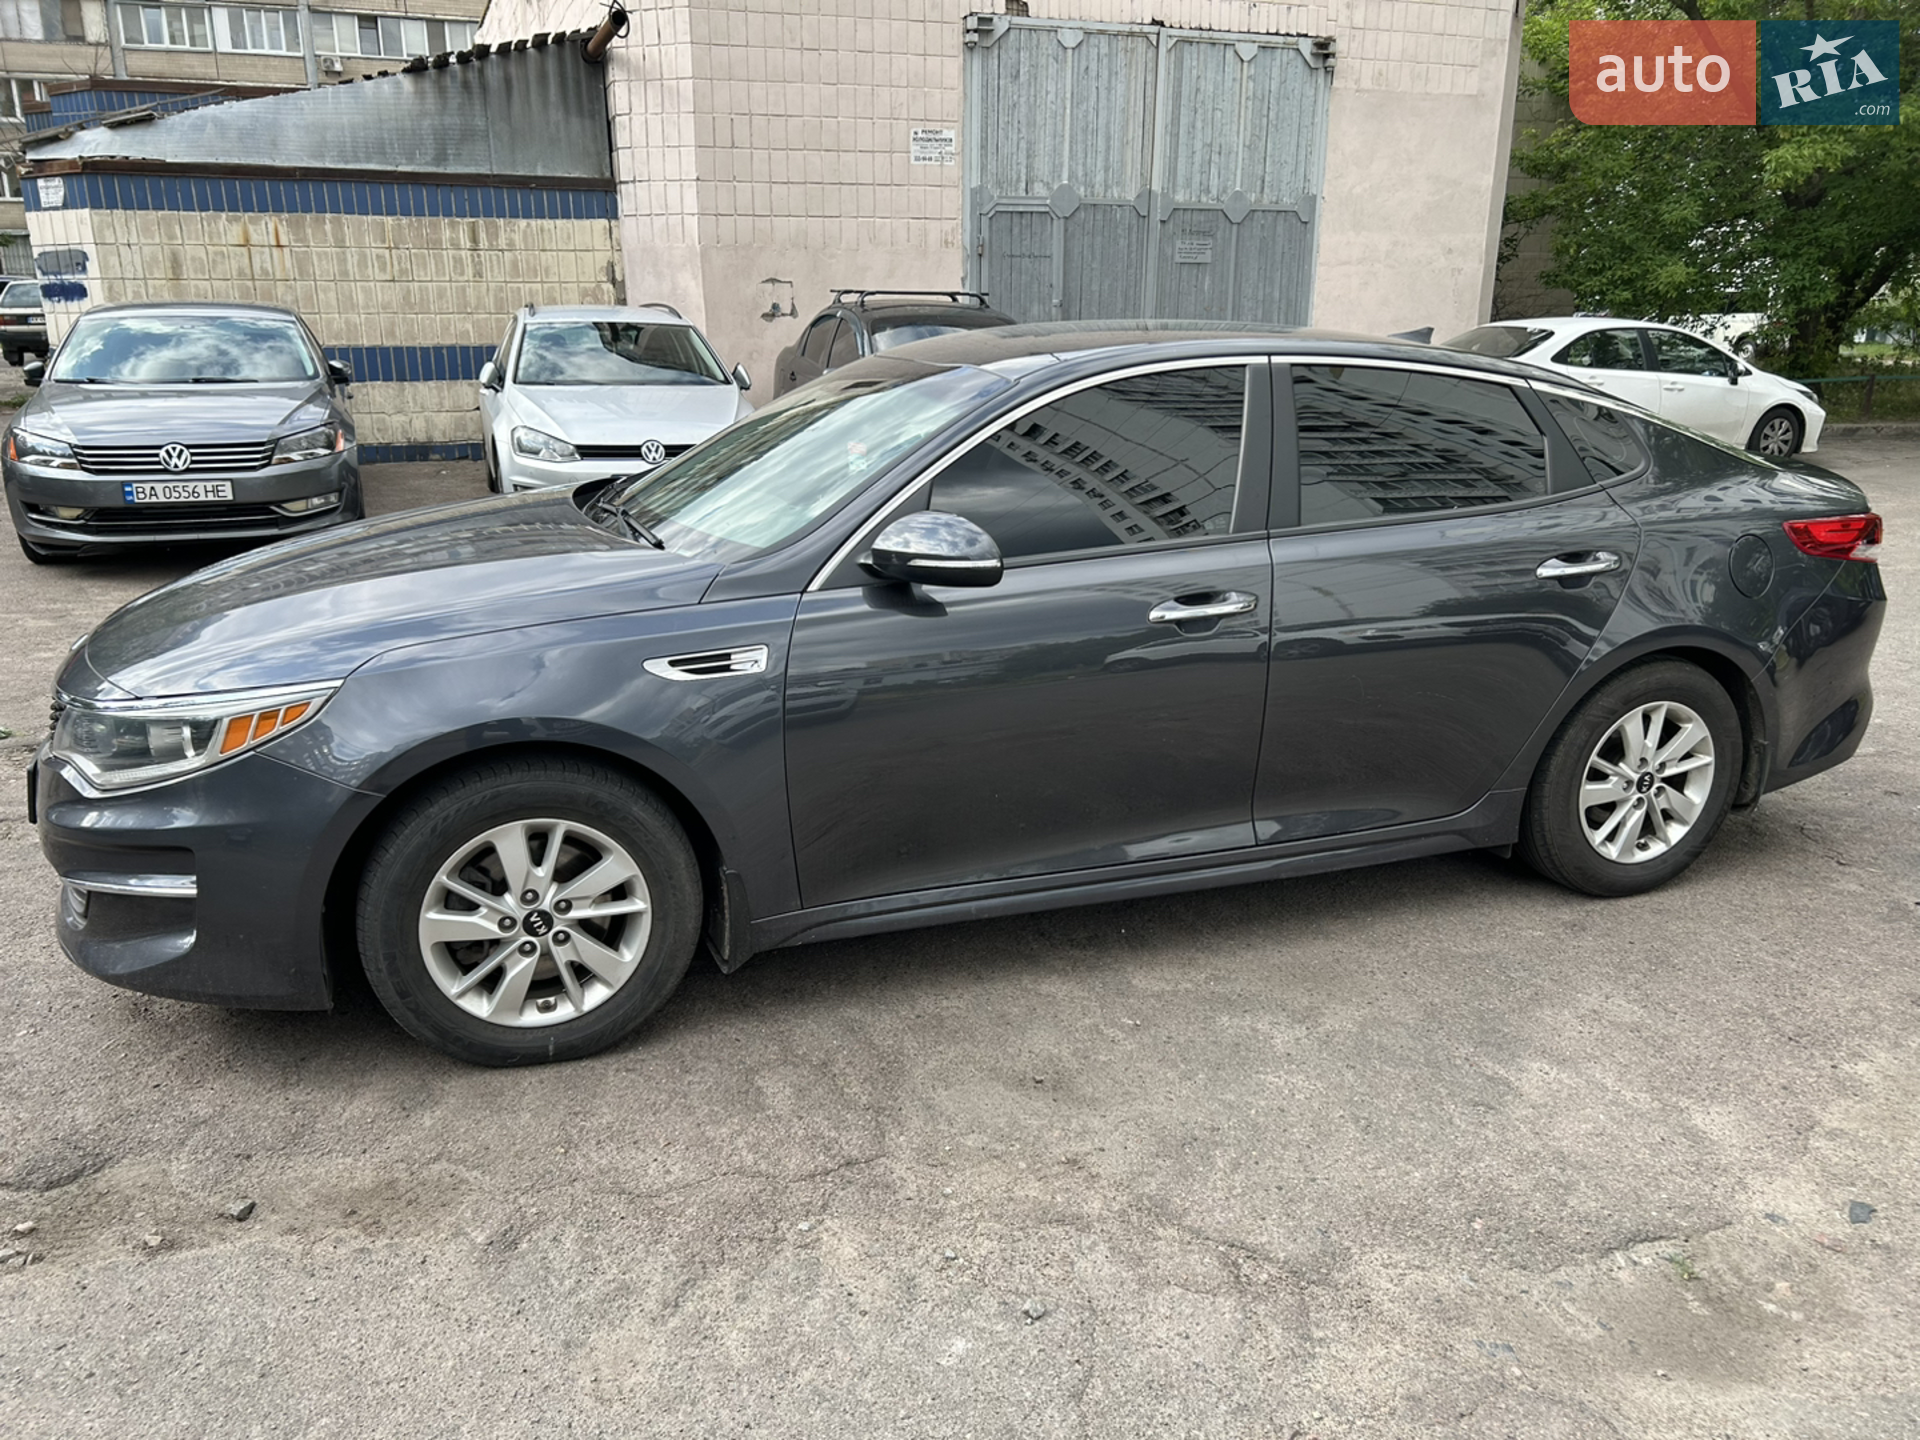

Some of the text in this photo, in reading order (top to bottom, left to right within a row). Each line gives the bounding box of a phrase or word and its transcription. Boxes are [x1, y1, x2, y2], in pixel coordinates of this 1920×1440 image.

[135, 484, 228, 501] BA 0556 HE
[529, 911, 549, 936] KIA
